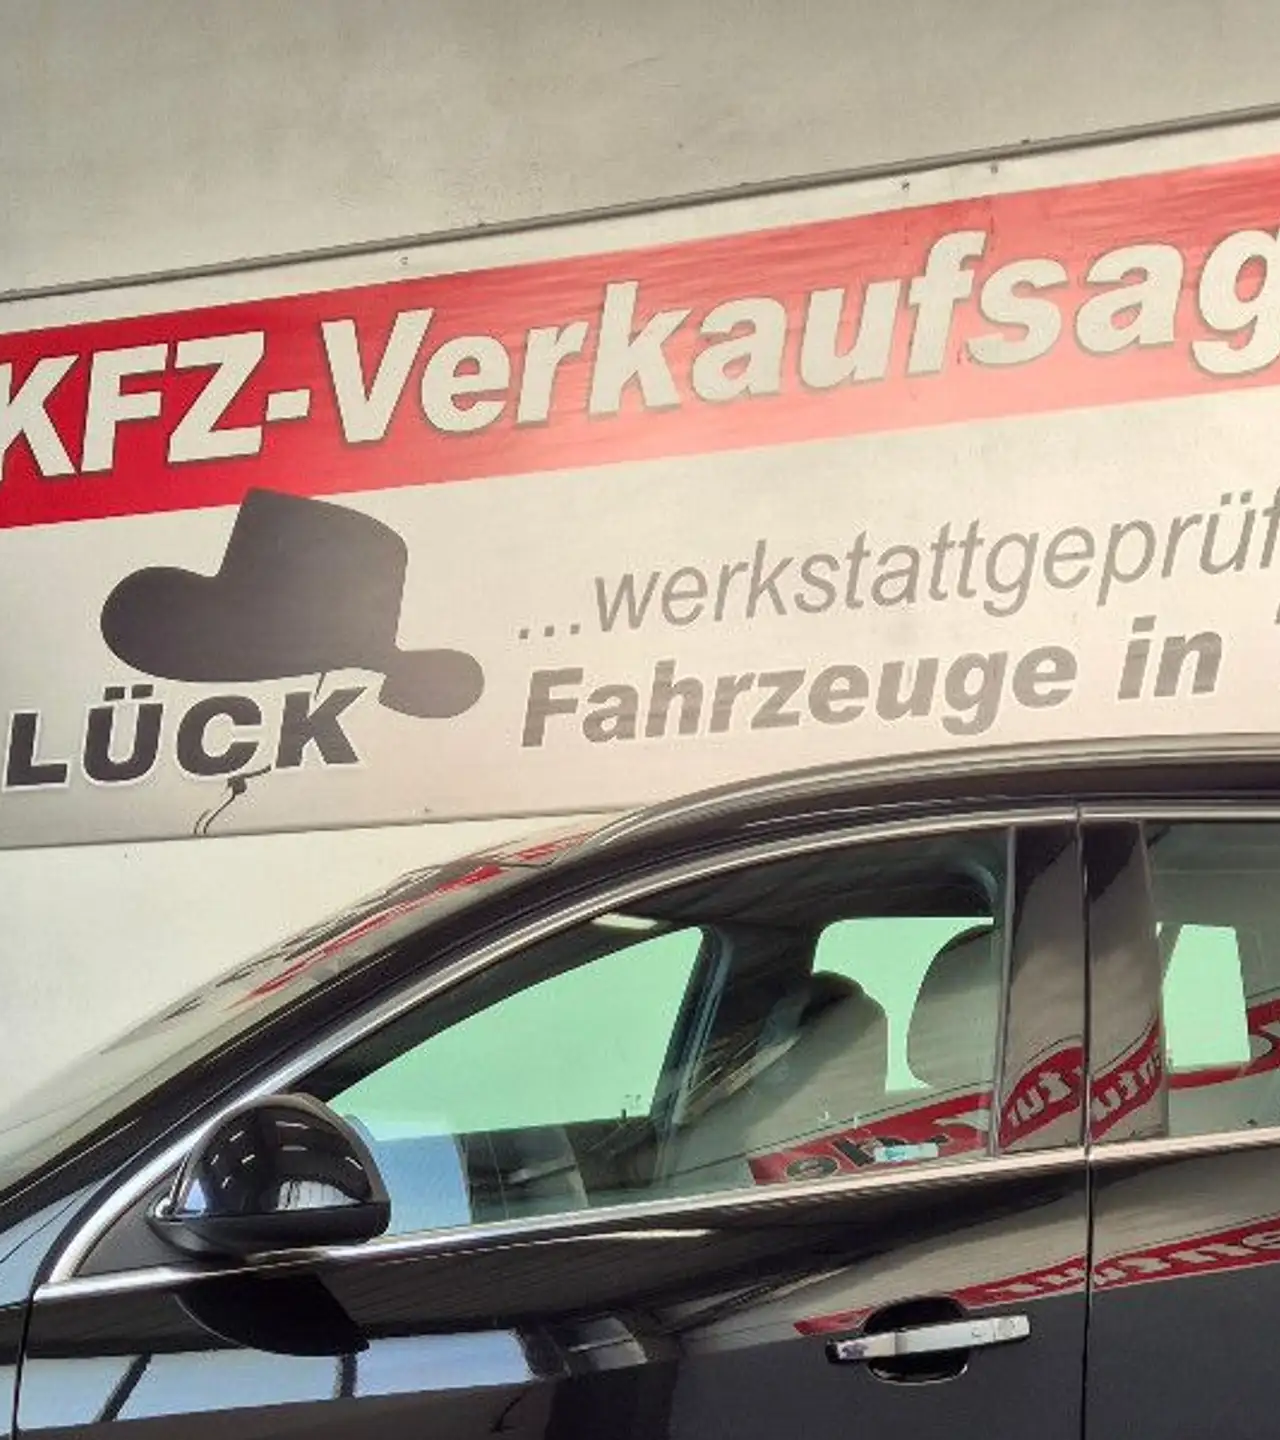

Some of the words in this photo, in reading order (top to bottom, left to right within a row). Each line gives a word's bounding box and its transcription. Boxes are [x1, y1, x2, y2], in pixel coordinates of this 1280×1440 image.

[4, 682, 368, 786] LÜCK
[520, 645, 1078, 748] Fahrzeuge
[1118, 614, 1224, 702] in
